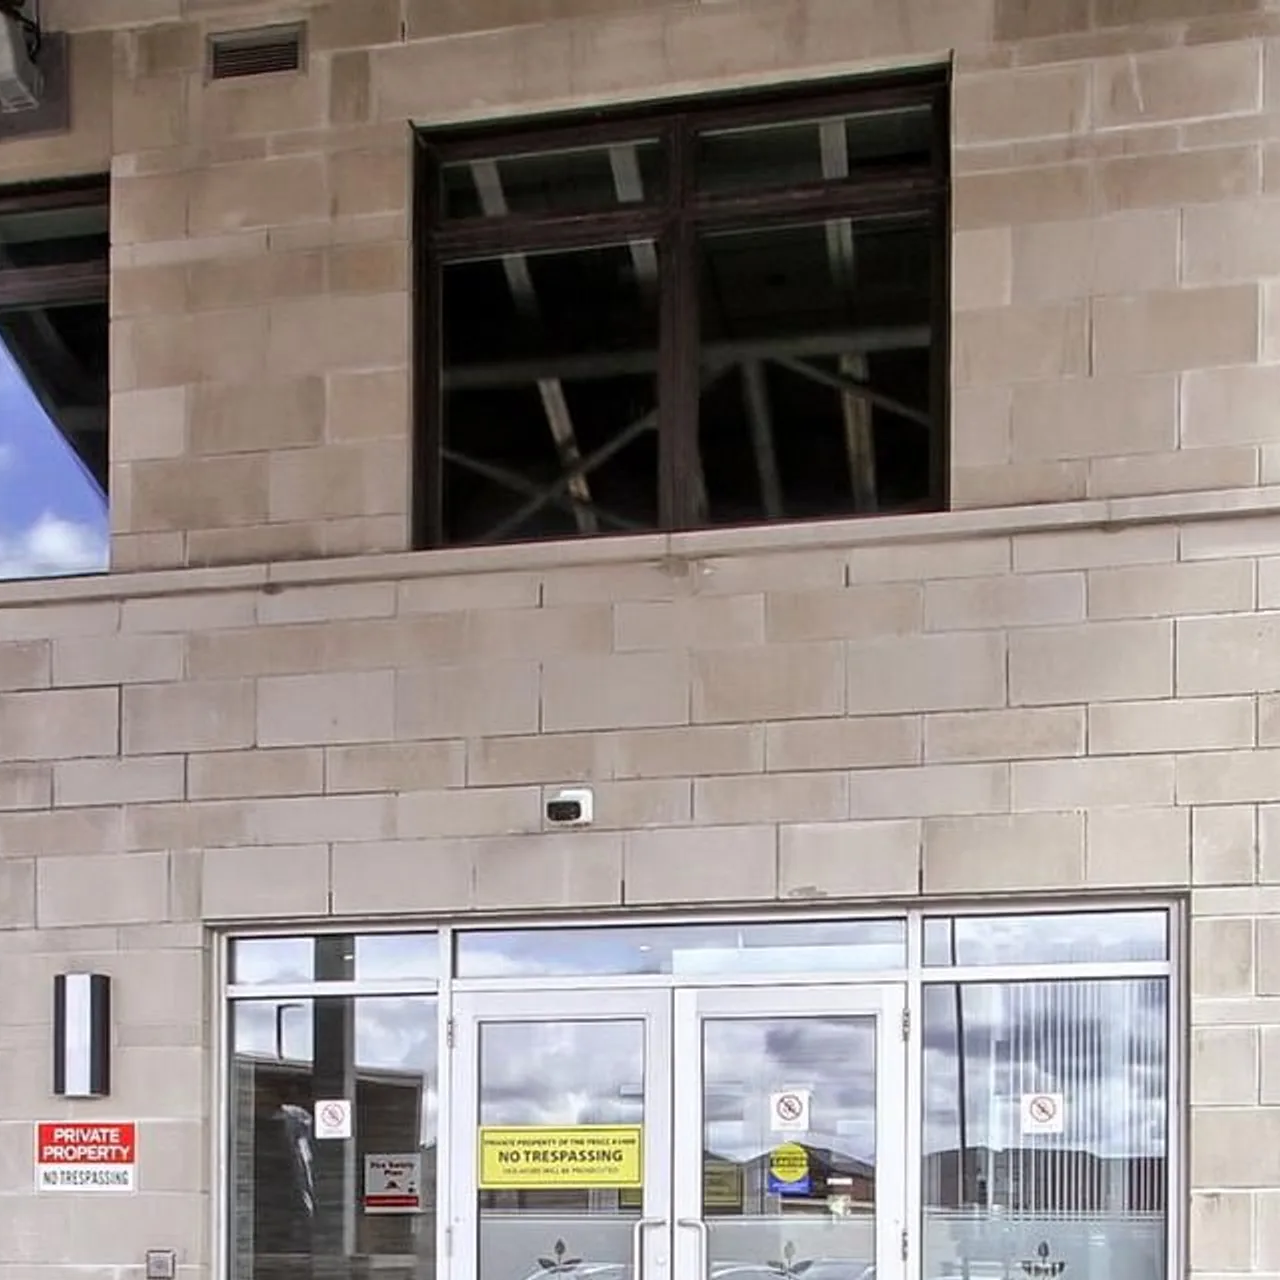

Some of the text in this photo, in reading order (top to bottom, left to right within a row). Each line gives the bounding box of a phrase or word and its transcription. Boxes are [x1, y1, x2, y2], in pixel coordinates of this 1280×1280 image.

[53, 1128, 120, 1143] PRIVATE
[43, 1145, 130, 1161] PROPERTY
[498, 1149, 624, 1163] NO TRESPASSING
[43, 1170, 129, 1185] NO TRESPASSING
